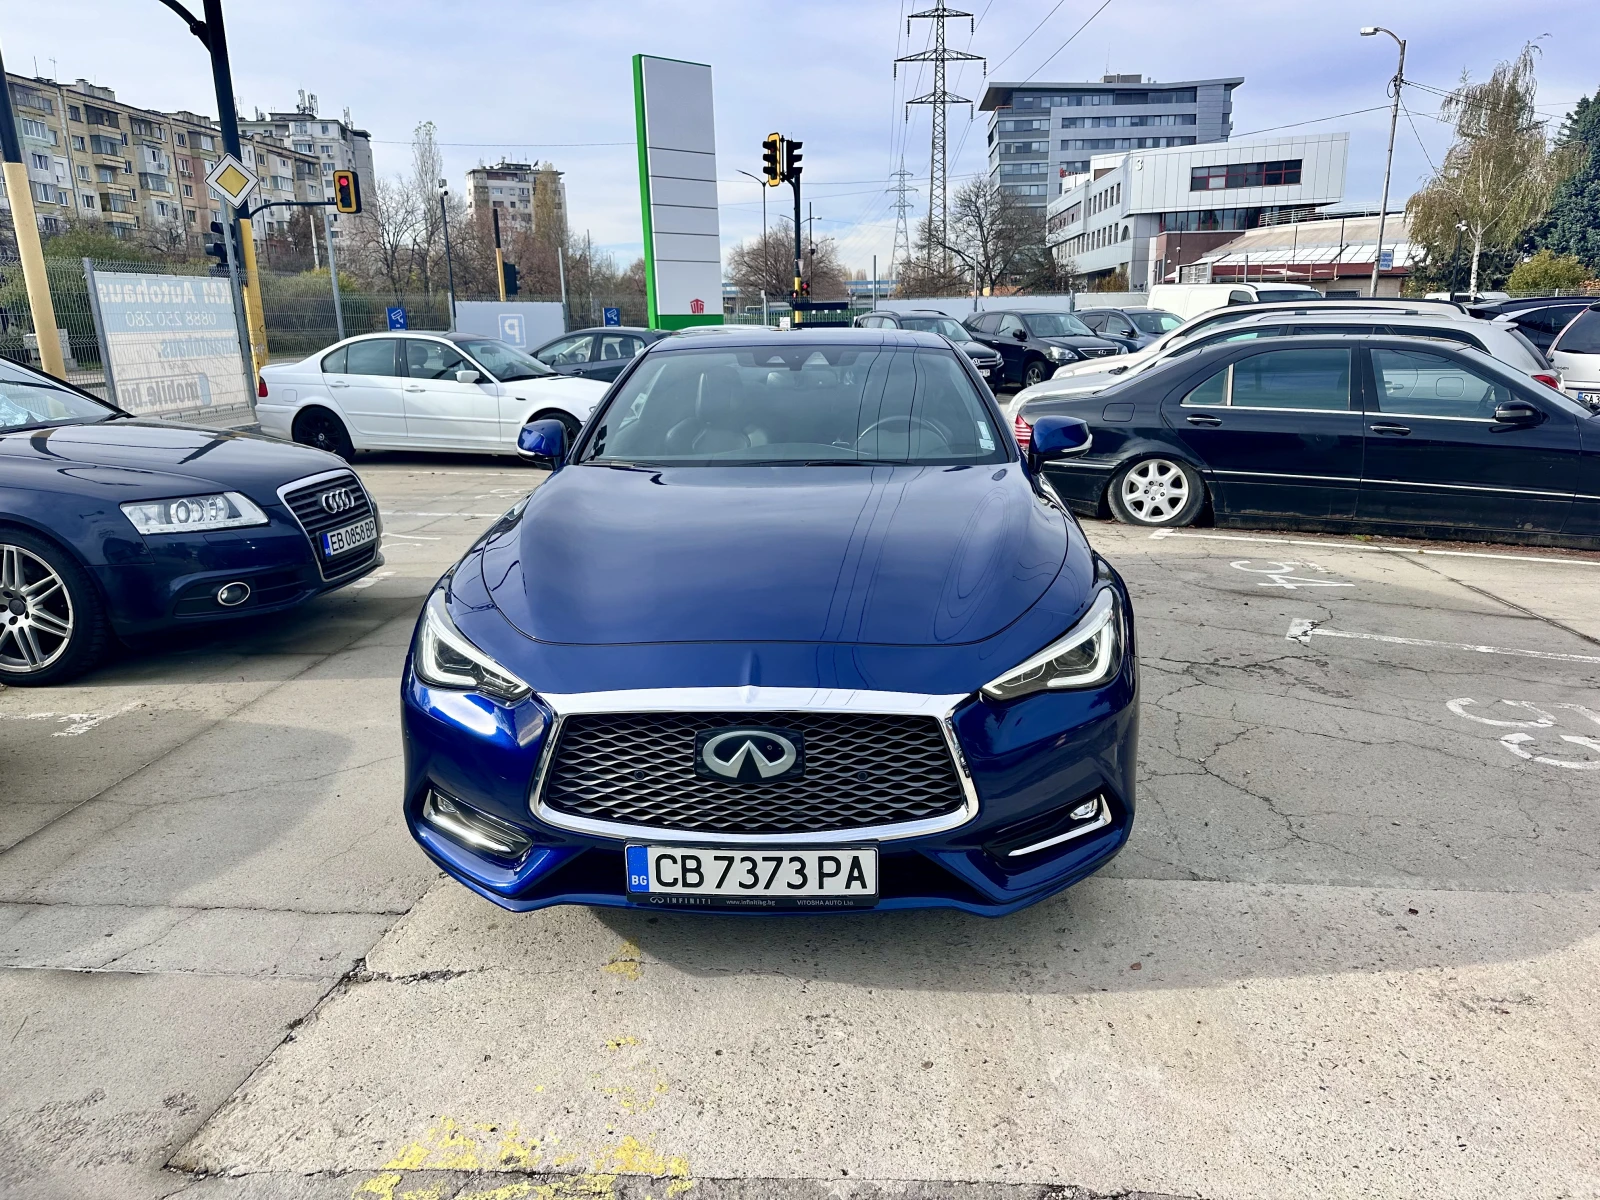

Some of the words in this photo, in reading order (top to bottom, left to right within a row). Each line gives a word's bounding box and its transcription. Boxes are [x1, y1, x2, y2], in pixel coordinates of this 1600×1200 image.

[330, 531, 345, 552] EB
[345, 525, 366, 546] 0858
[365, 520, 375, 538] BP
[631, 875, 648, 886] BG
[655, 853, 705, 888] CB
[713, 855, 808, 890] 7373
[817, 855, 868, 890] PA
[667, 897, 711, 905] INFINITI
[796, 899, 824, 907] VITOSHA
